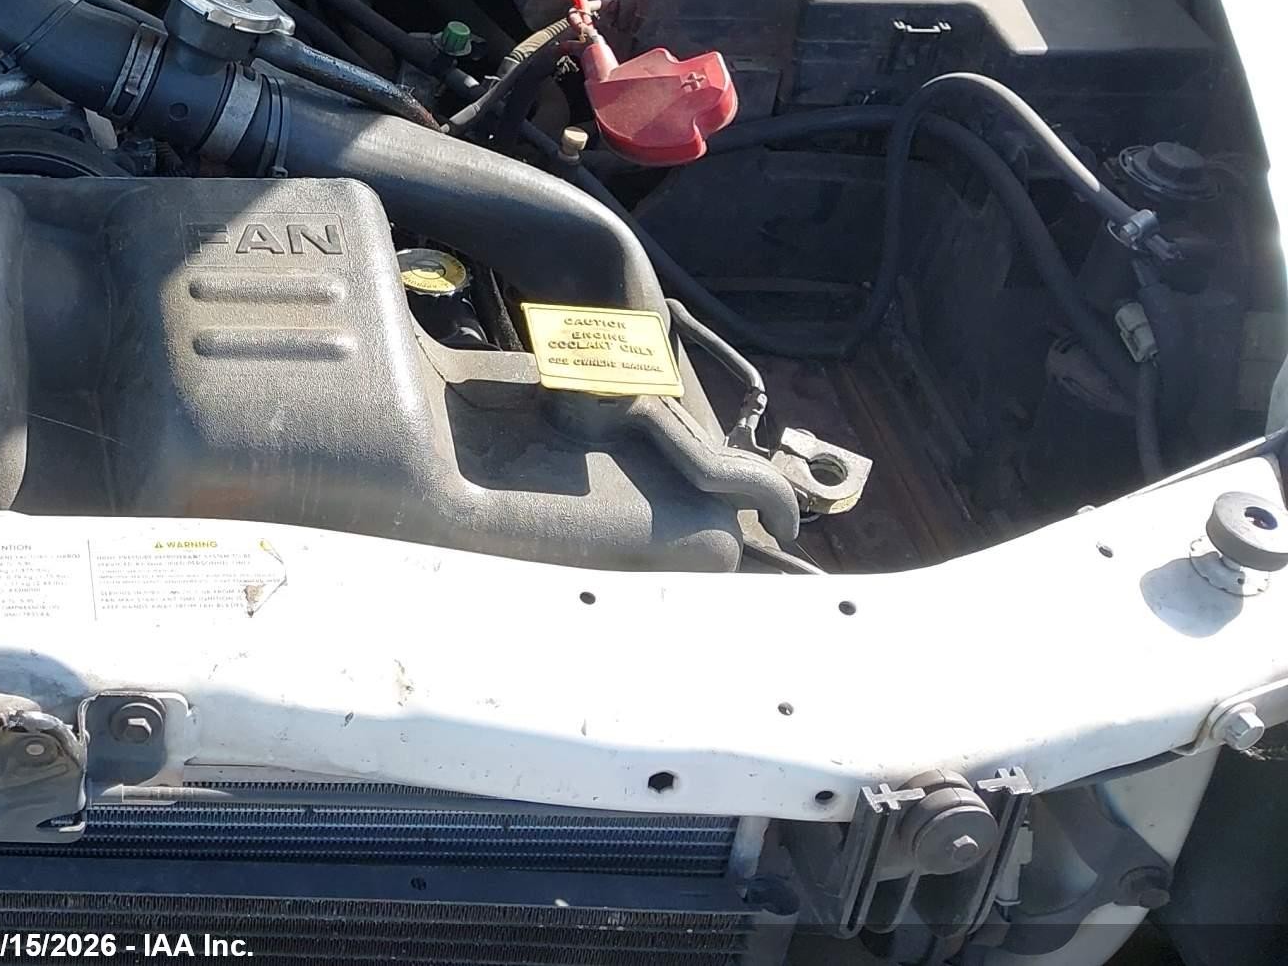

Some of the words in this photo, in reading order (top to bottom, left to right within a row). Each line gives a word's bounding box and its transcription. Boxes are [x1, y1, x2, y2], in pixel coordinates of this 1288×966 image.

[186, 224, 343, 255] FAN
[564, 318, 626, 329] CAUTION
[572, 331, 628, 343] ENGINE
[548, 340, 613, 350] COOLANT
[619, 344, 654, 356] ONLY
